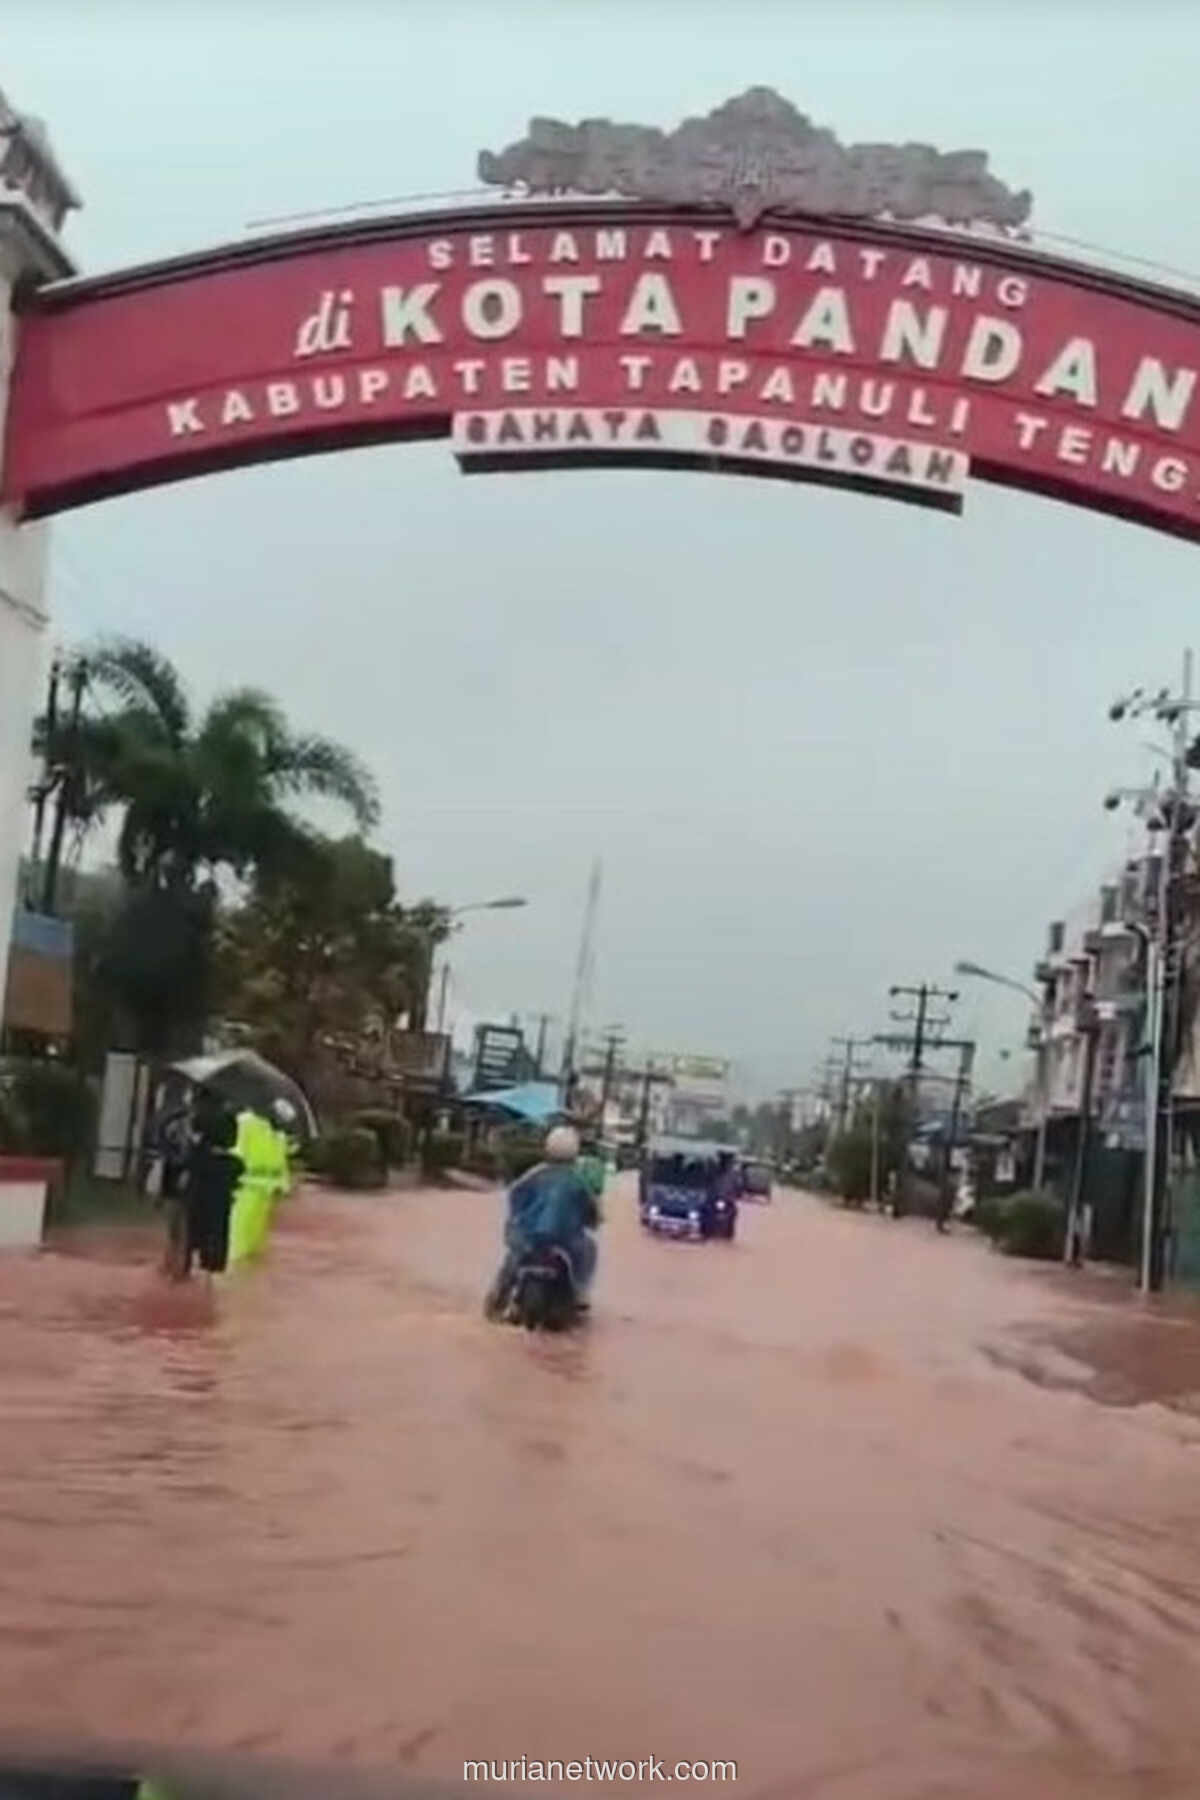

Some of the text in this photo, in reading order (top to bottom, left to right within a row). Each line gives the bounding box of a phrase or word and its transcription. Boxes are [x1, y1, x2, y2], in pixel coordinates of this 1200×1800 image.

[428, 229, 1028, 306] SELAMAT DATANG
[294, 272, 1198, 430] di KOTA PANDAN
[167, 355, 1200, 502] KABUPATEN TAPANULI TENG
